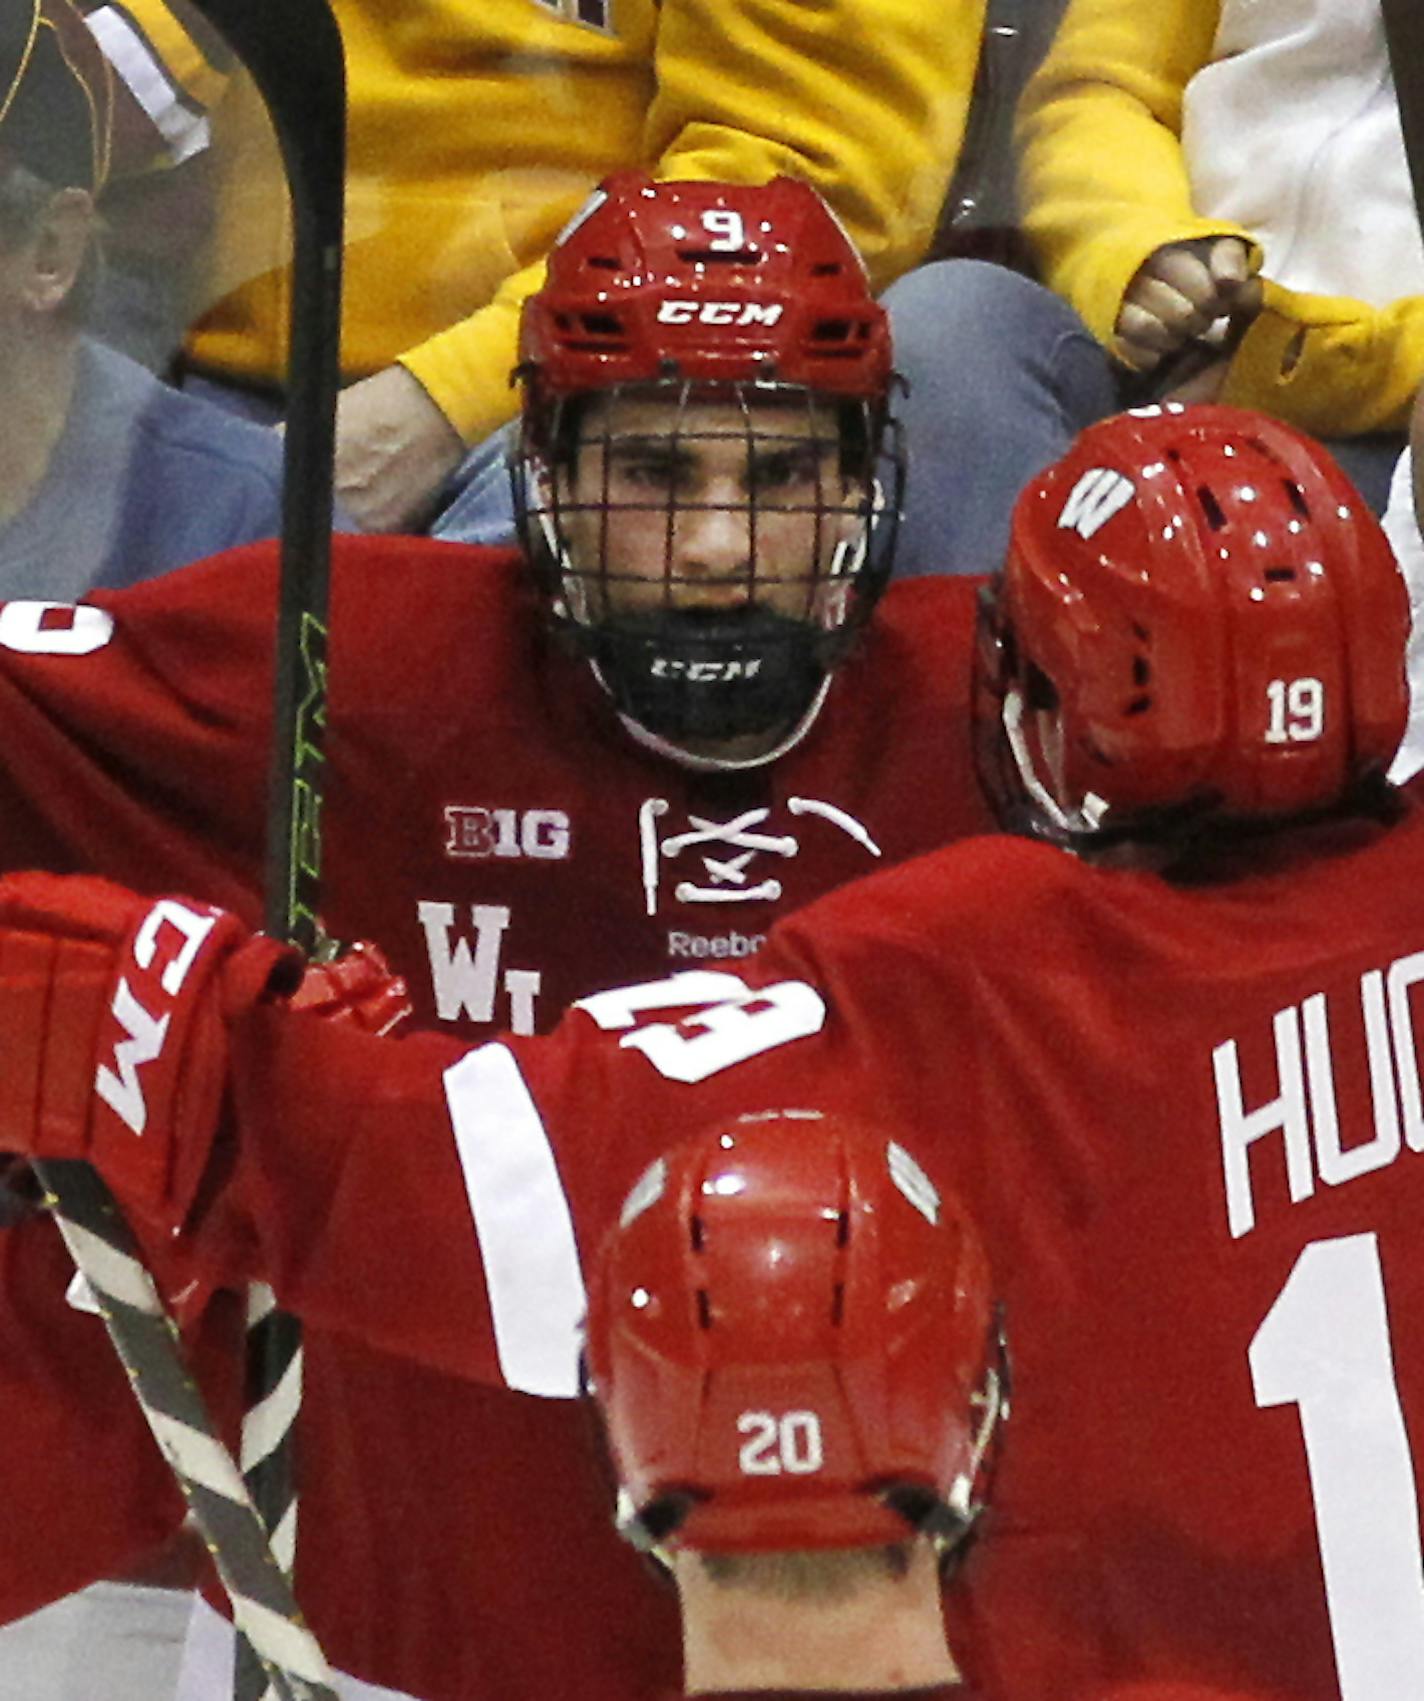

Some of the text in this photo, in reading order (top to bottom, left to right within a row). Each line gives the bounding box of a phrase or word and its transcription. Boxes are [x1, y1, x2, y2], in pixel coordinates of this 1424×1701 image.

[701, 210, 744, 251] 9
[657, 301, 783, 325] CCM
[1057, 467, 1136, 540] W
[650, 657, 762, 681] CCM
[1264, 677, 1325, 743] 19
[95, 899, 217, 1137] CM
[736, 1409, 824, 1476] 20
